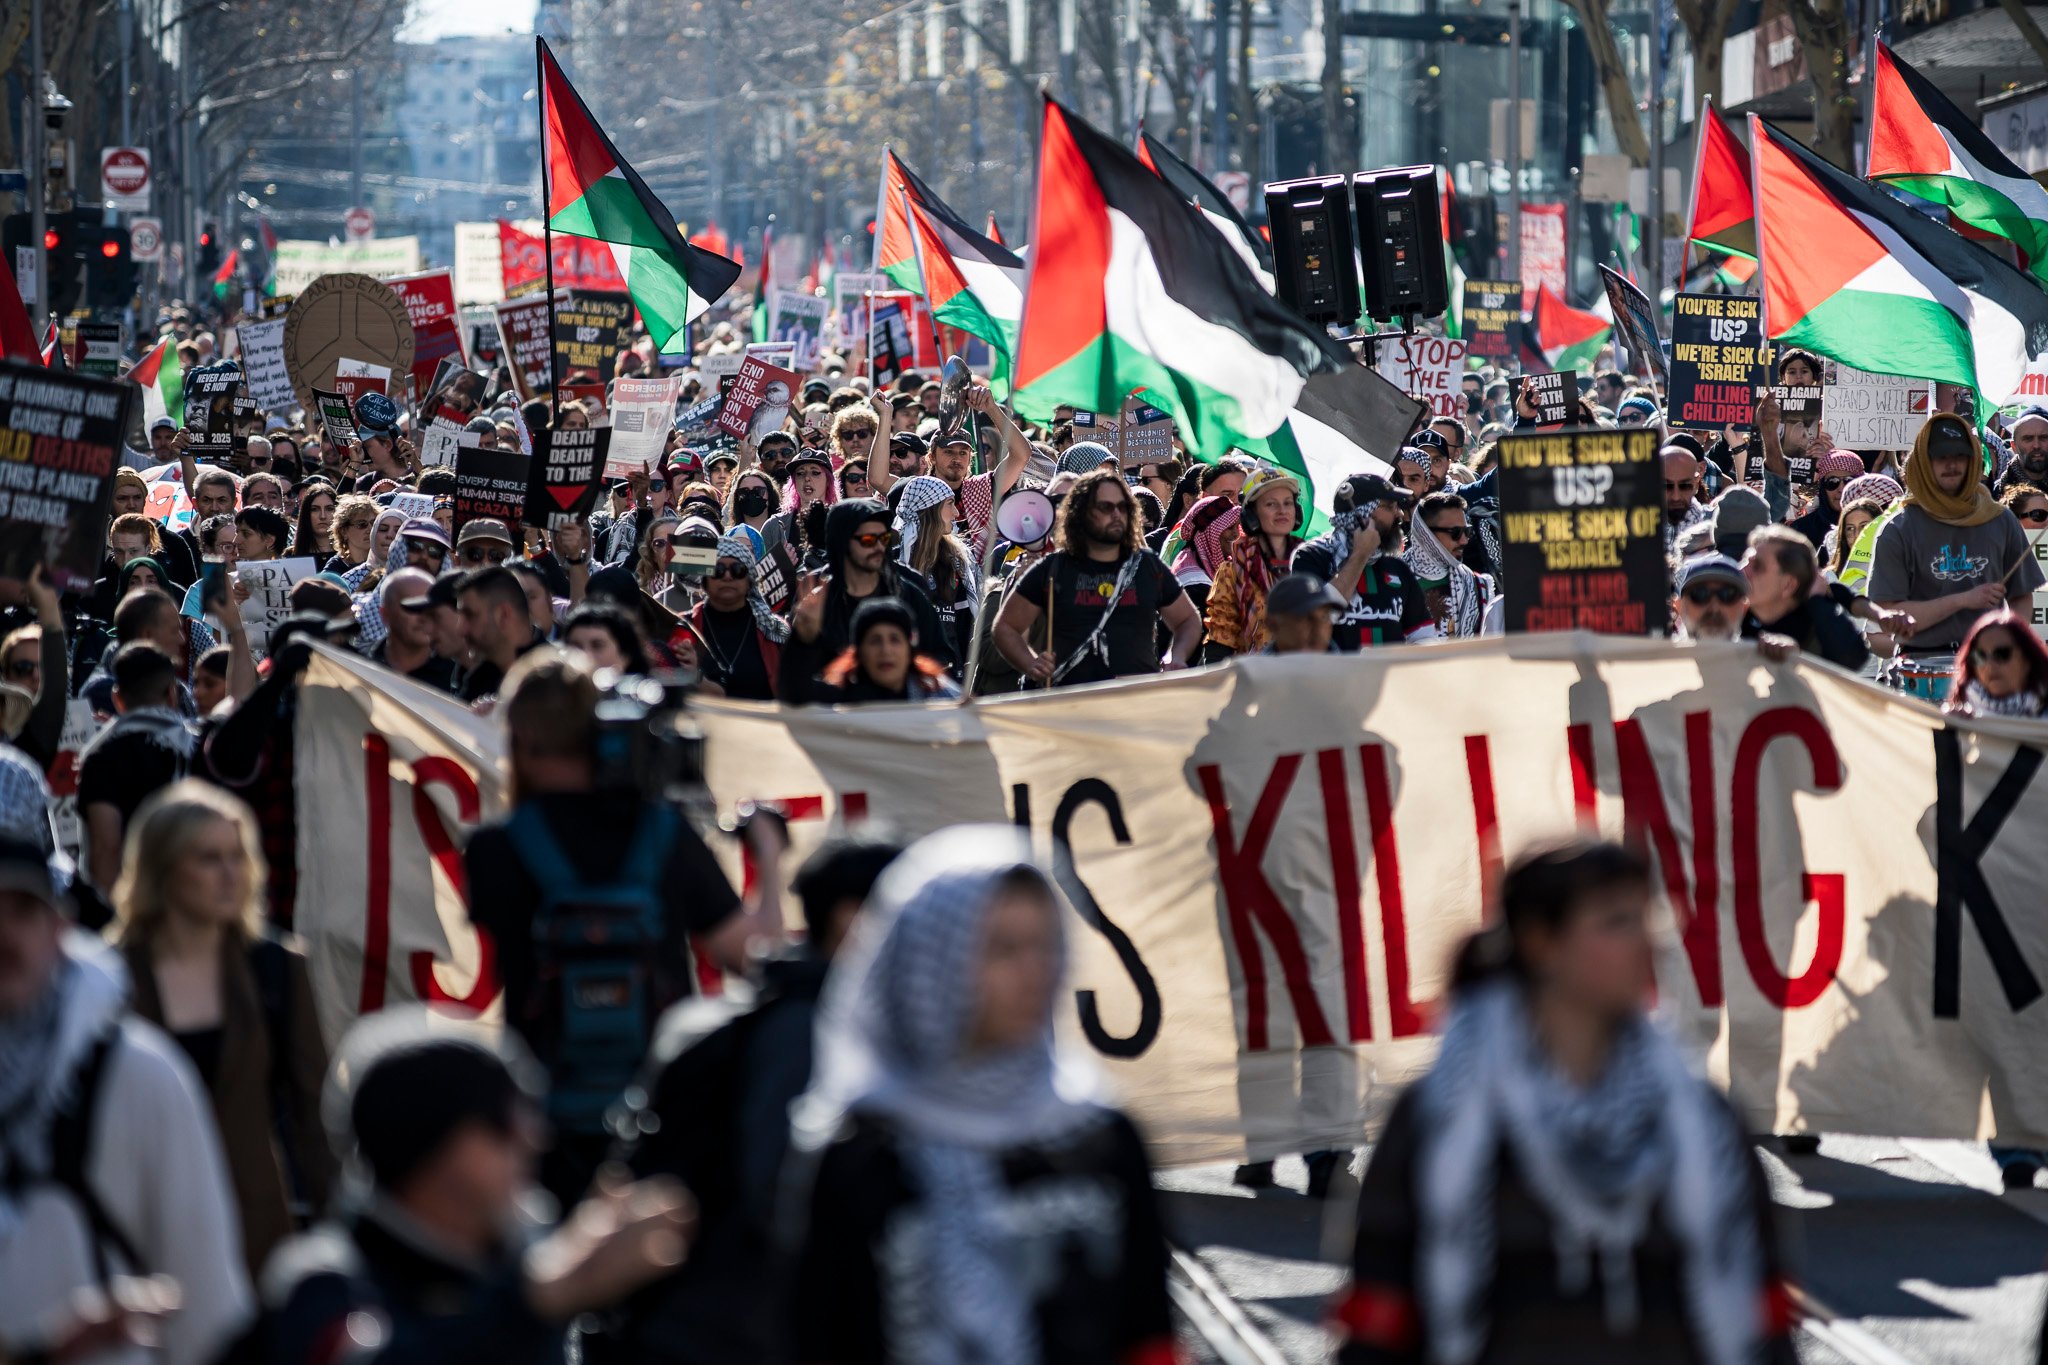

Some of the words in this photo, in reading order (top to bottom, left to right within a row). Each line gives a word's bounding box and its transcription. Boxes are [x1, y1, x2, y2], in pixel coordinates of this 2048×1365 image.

[503, 237, 613, 280] SOCIAL
[409, 302, 446, 319] ENCE
[1677, 298, 1724, 317] YOU'RE
[1726, 300, 1758, 319] SICK
[529, 316, 550, 329] GA
[556, 313, 583, 326] YOU'RE
[576, 326, 600, 342] US?
[1710, 318, 1748, 343] US?
[555, 341, 583, 355] WE'RE
[1395, 336, 1467, 369] STOP
[1675, 343, 1720, 363] WE'RE
[1722, 346, 1755, 365] SICK
[196, 373, 220, 384] NEVER
[219, 371, 241, 383] AGAIN
[741, 362, 765, 380] END
[1403, 367, 1451, 390] THE
[1697, 362, 1753, 382] 'ISRAEL'
[202, 383, 210, 392] IS
[209, 382, 228, 392] NOW
[335, 381, 355, 394] END
[736, 375, 759, 393] THE
[1532, 373, 1562, 390] EATH
[14, 375, 86, 415] NUMBER
[84, 391, 120, 421] ONE
[731, 387, 762, 409] SIEGE
[1540, 389, 1564, 406] ATH
[1694, 384, 1751, 405] KILLING
[1789, 386, 1821, 399] AGAIN
[1826, 388, 1871, 412] STAND
[367, 395, 391, 410] GAZA
[696, 403, 715, 417] NOW
[725, 400, 742, 416] ON
[1782, 398, 1806, 411] NOW
[1544, 405, 1567, 421] THE
[9, 405, 62, 438] CAUSE
[61, 415, 86, 441] OF
[720, 411, 748, 435] GAZA
[1826, 415, 1918, 445] PALESTINE
[211, 432, 232, 444] 2025
[551, 430, 597, 446] DEATH
[1137, 428, 1166, 438] COLONIES
[1424, 432, 1433, 442] 7
[0, 427, 33, 463] ILD
[32, 434, 115, 477] DEATHS
[550, 447, 595, 465] DEATH
[1147, 447, 1169, 458] LANDS
[1500, 436, 1575, 469] YOU'RE
[1575, 434, 1626, 466] SICK
[1628, 431, 1658, 462] OF
[36, 464, 101, 503] PLANET
[545, 466, 567, 483] TO
[568, 465, 593, 481] THE
[457, 475, 490, 487] EVERY
[491, 479, 528, 493] SINGLE
[1552, 463, 1614, 507] US?
[456, 488, 496, 501] HUMAN
[11, 493, 69, 528] ISRAEL
[457, 500, 470, 512] IN
[473, 500, 510, 517] GAZA
[1503, 510, 1575, 544] WE'RE
[1576, 507, 1628, 541] SICK
[1631, 505, 1662, 538] OF
[1539, 535, 1628, 571] 'ISRAEL'
[755, 552, 777, 580] ATH
[262, 567, 295, 588] PA
[759, 568, 784, 597] EATH
[768, 583, 790, 606] THE
[1539, 571, 1629, 605] KILLING
[1525, 601, 1647, 636] CHILDREN!
[1011, 777, 1162, 1059] S
[1197, 705, 1846, 1053] KILNG
